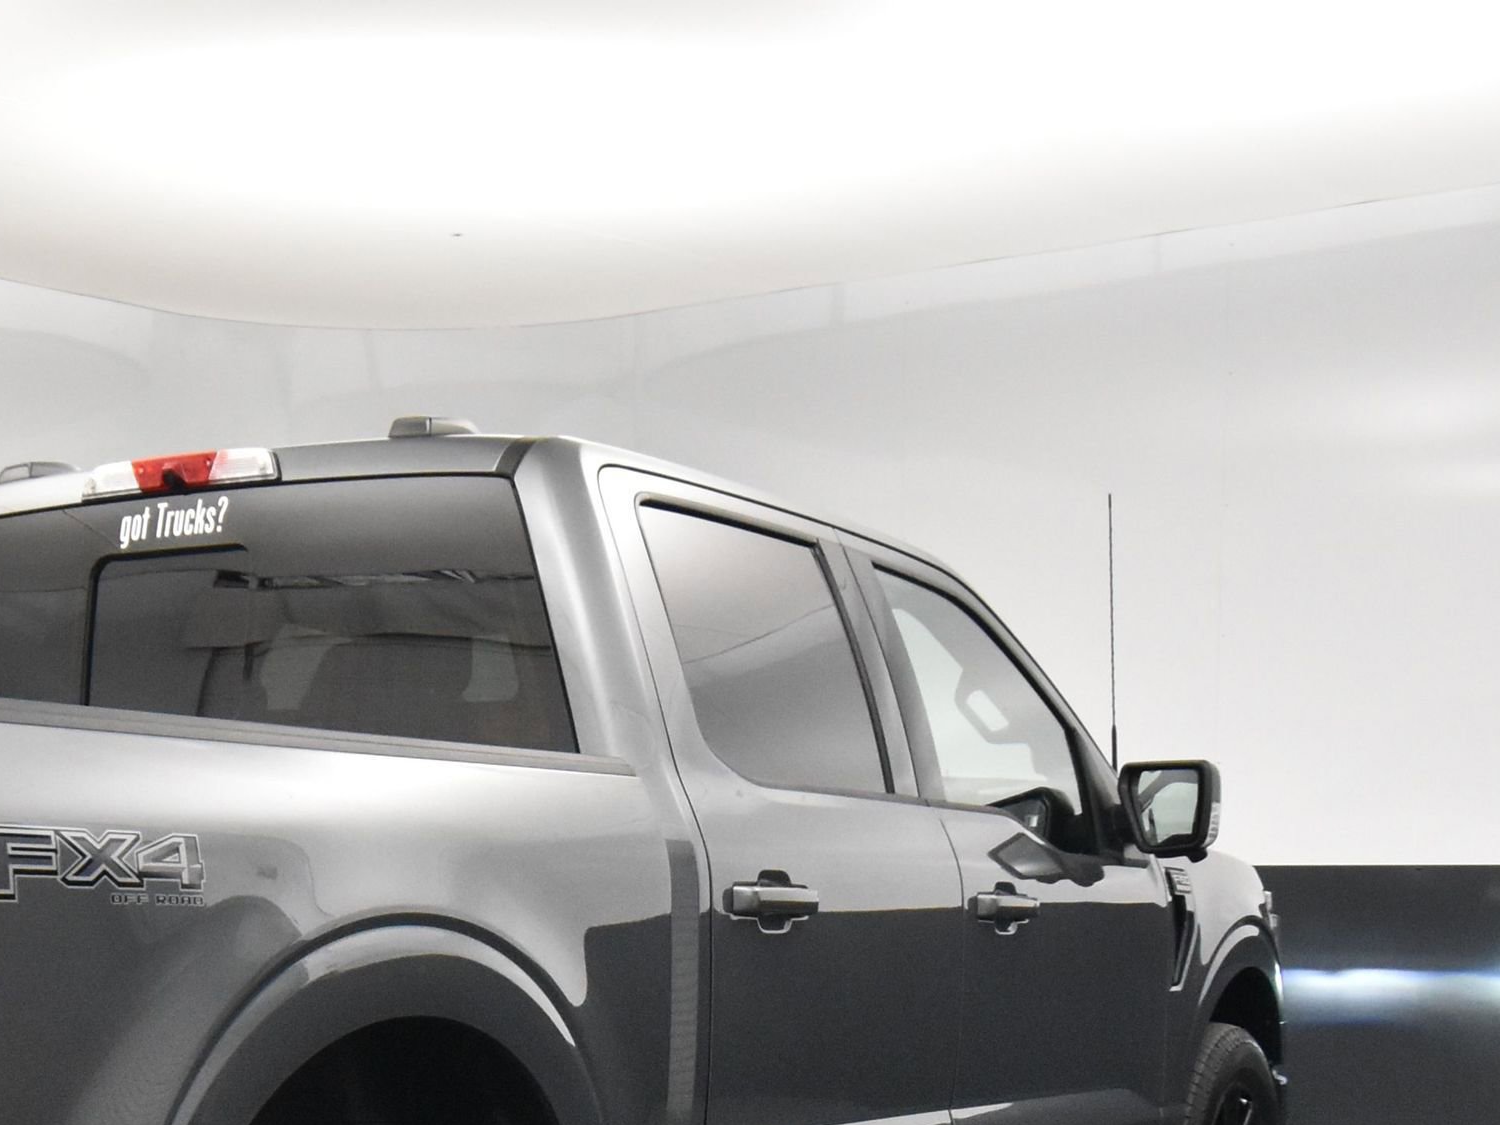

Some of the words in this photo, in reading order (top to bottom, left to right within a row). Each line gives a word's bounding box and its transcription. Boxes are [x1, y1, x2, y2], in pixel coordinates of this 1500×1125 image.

[120, 506, 150, 549] got
[156, 496, 229, 538] Trucks?
[110, 892, 150, 906] OFF
[155, 893, 206, 907] ROAD
